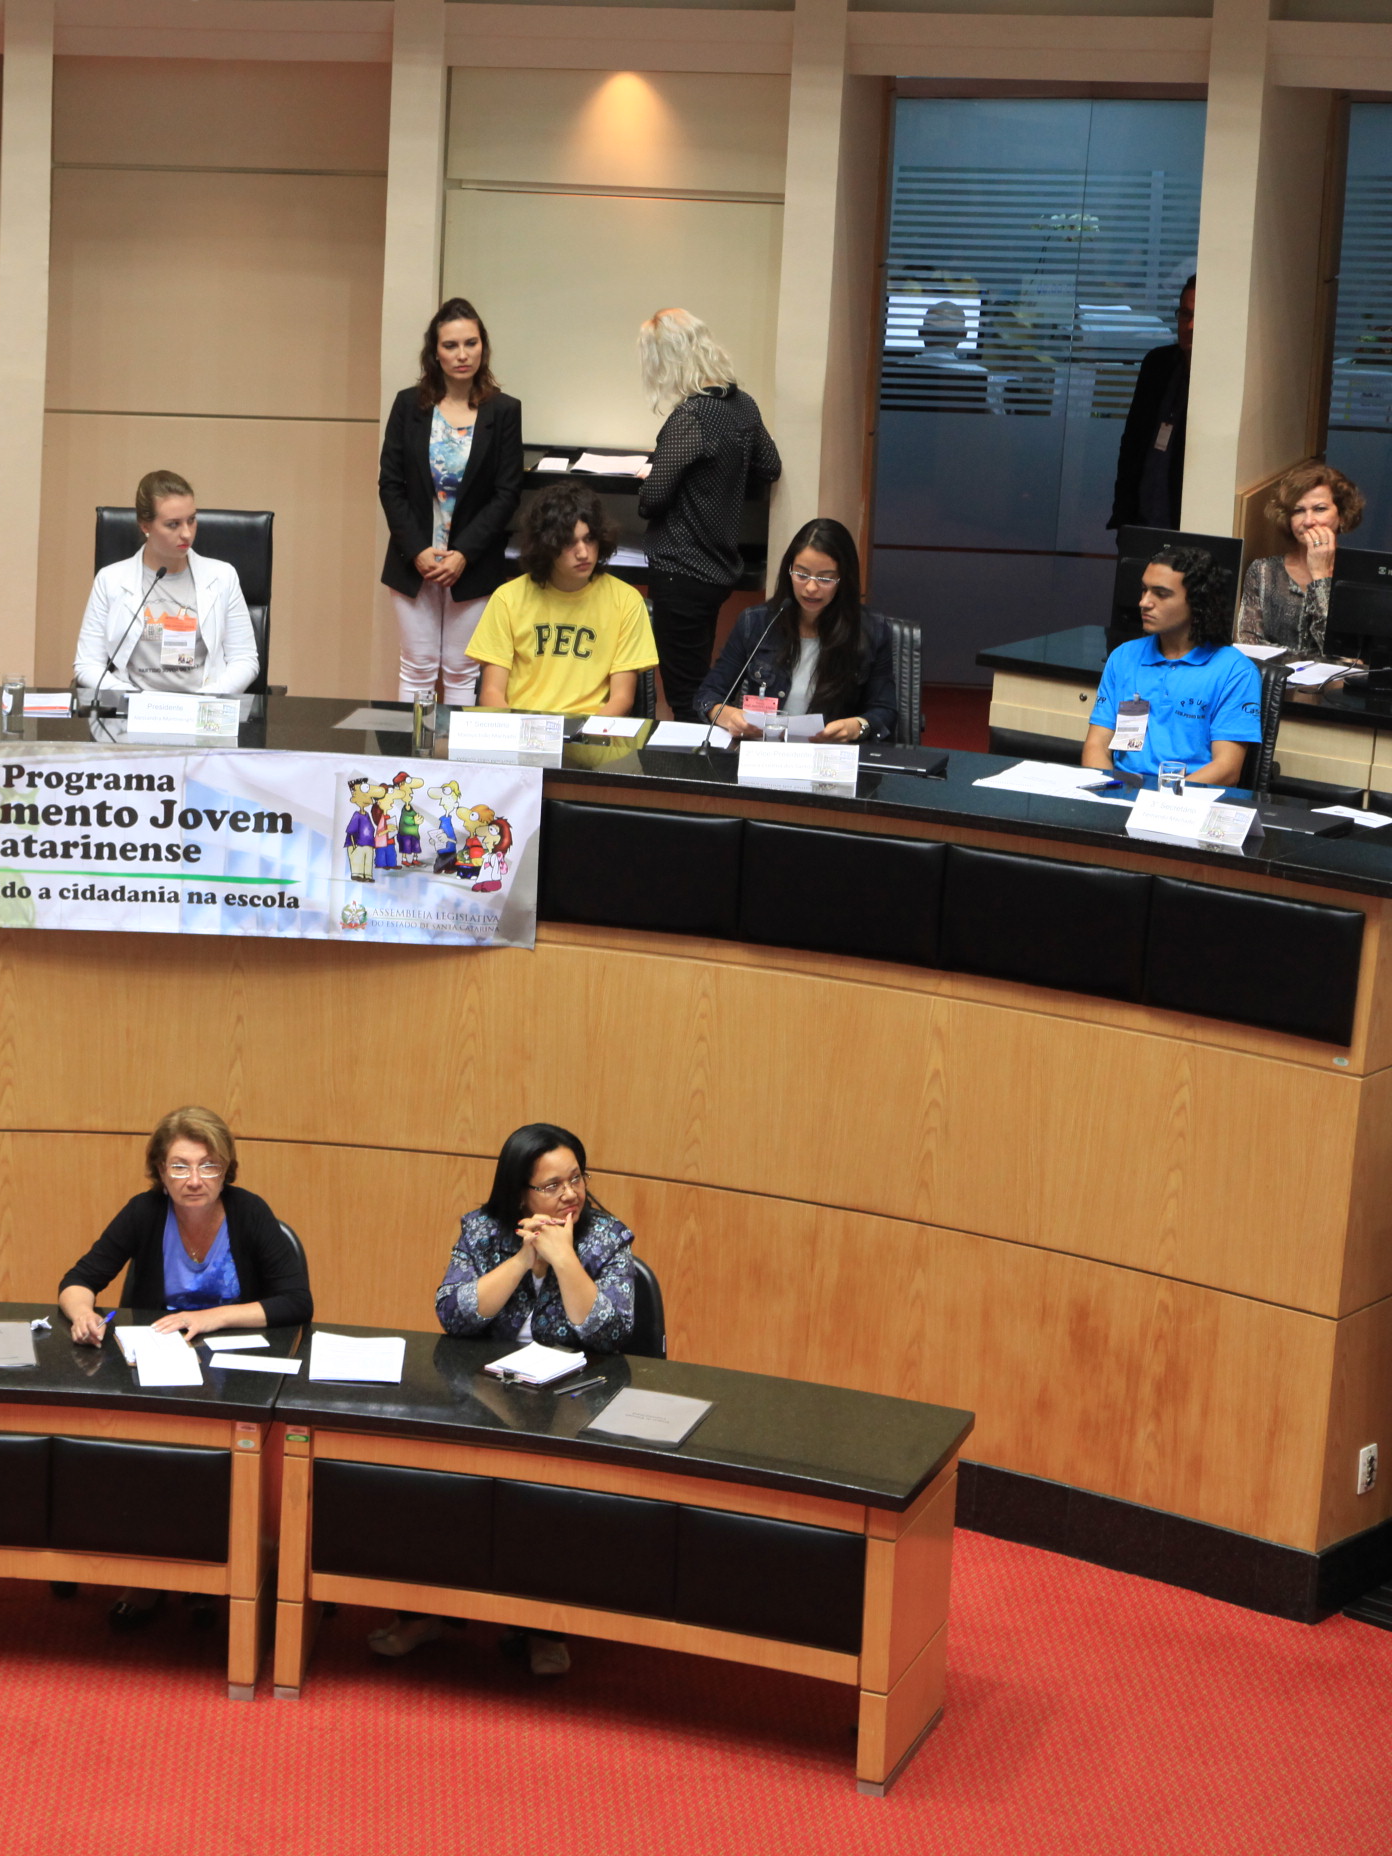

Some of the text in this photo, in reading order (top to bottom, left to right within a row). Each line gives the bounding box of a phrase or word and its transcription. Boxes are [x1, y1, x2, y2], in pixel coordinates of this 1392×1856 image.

[534, 624, 596, 660] PEC
[146, 702, 184, 713] Presidente
[2, 764, 176, 796] Programa
[149, 799, 294, 834] Jovem
[38, 886, 51, 900] a
[58, 883, 180, 903] cidadania
[187, 890, 217, 904] na
[224, 891, 300, 909] escola
[371, 919, 384, 927] DO
[386, 920, 417, 929] ESTADO
[432, 923, 457, 931] SANTA
[372, 908, 499, 923] ASSEMBLEIA LEGISLATIVA
